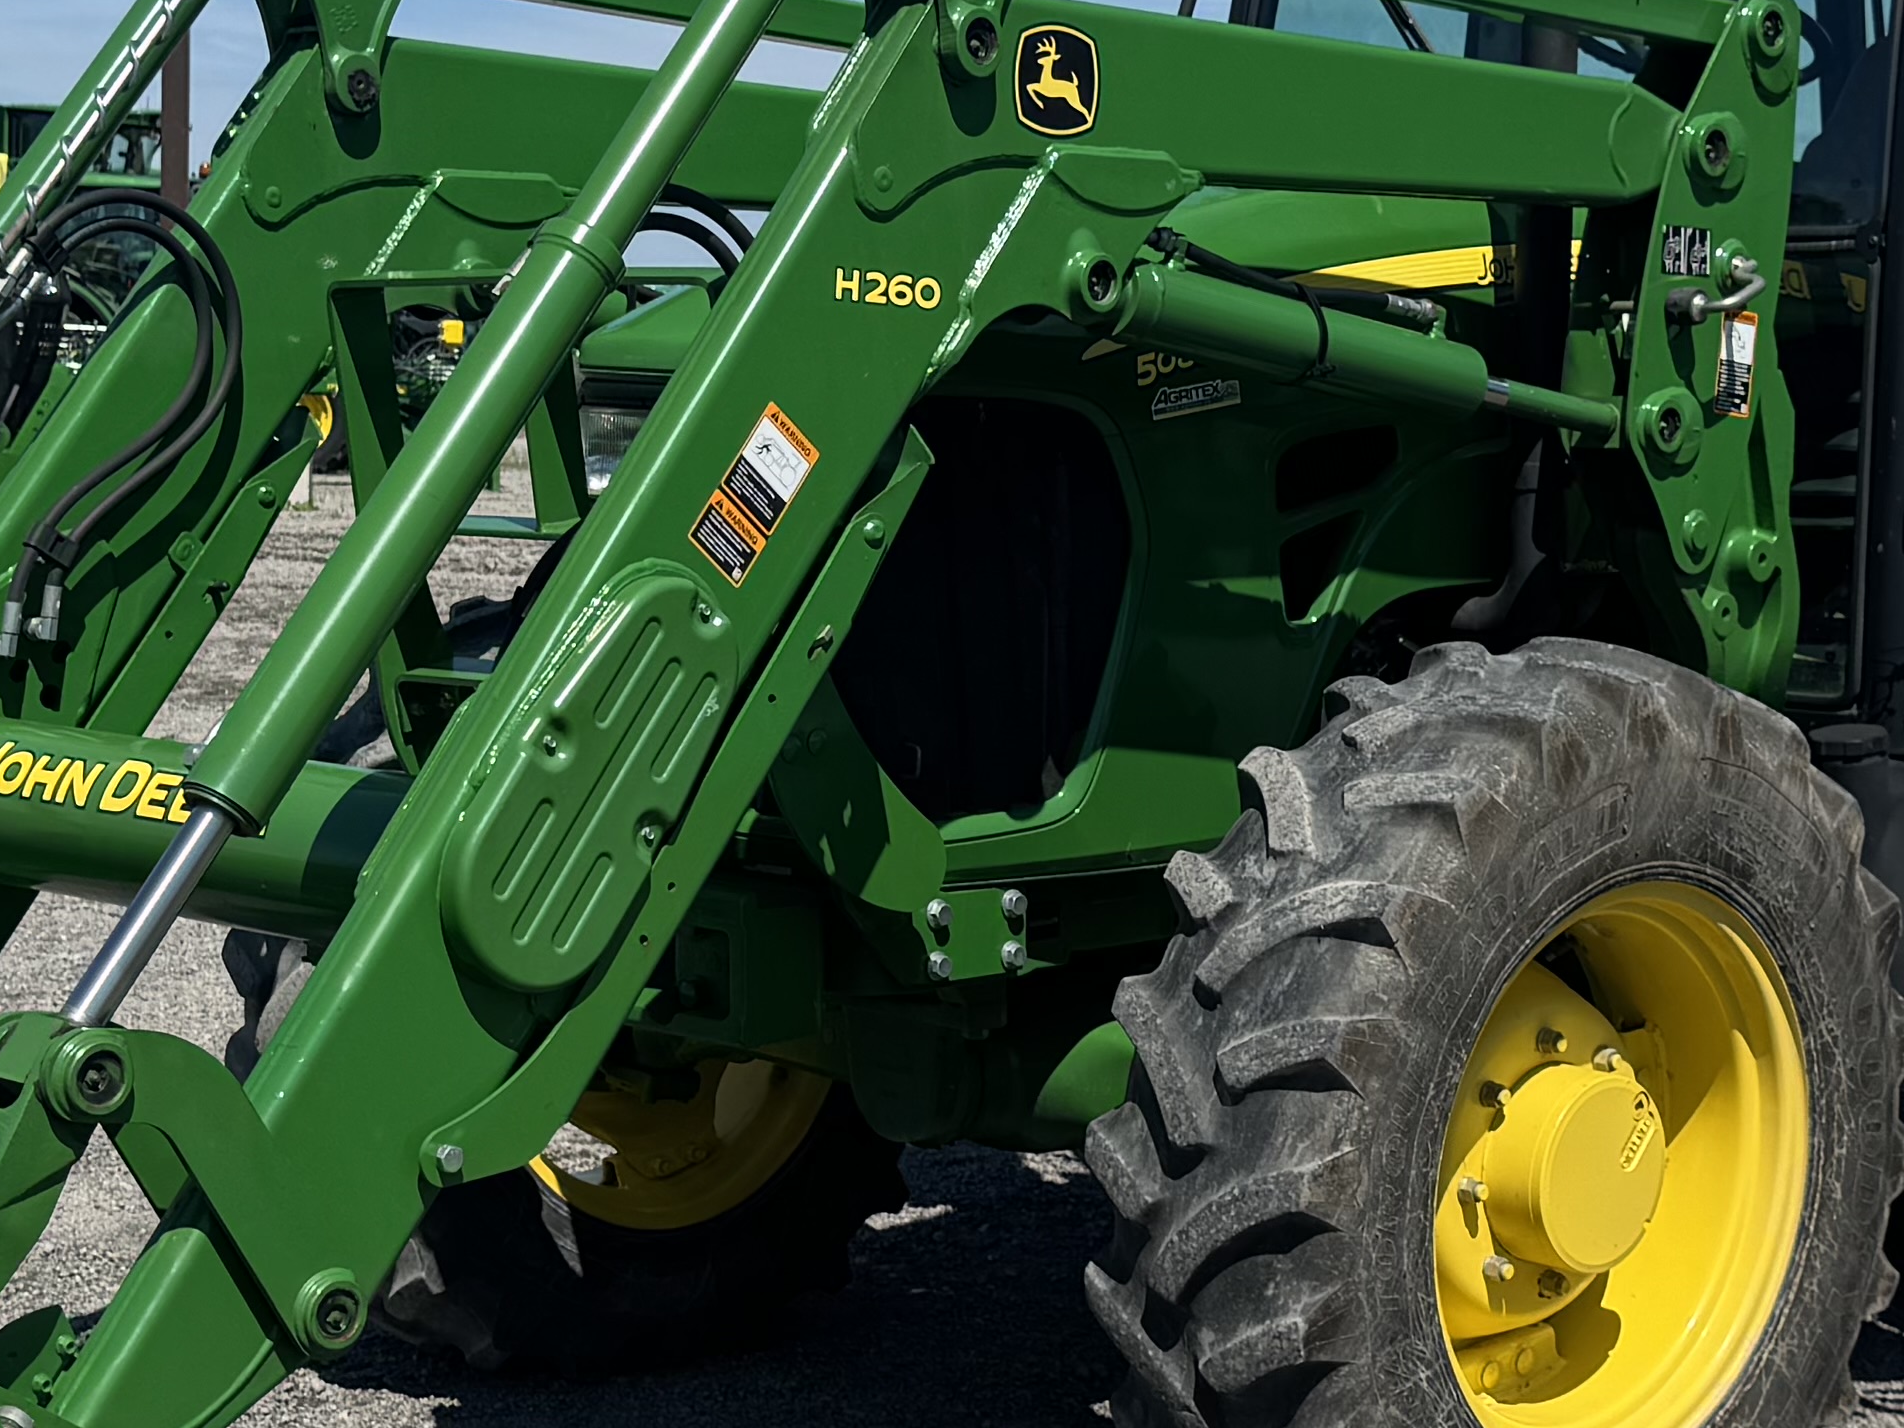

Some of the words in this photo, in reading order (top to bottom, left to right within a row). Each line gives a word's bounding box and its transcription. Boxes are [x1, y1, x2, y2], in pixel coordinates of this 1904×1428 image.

[1477, 253, 1516, 284] JOH
[835, 267, 941, 310] H260
[1154, 380, 1222, 407] AGRITEX
